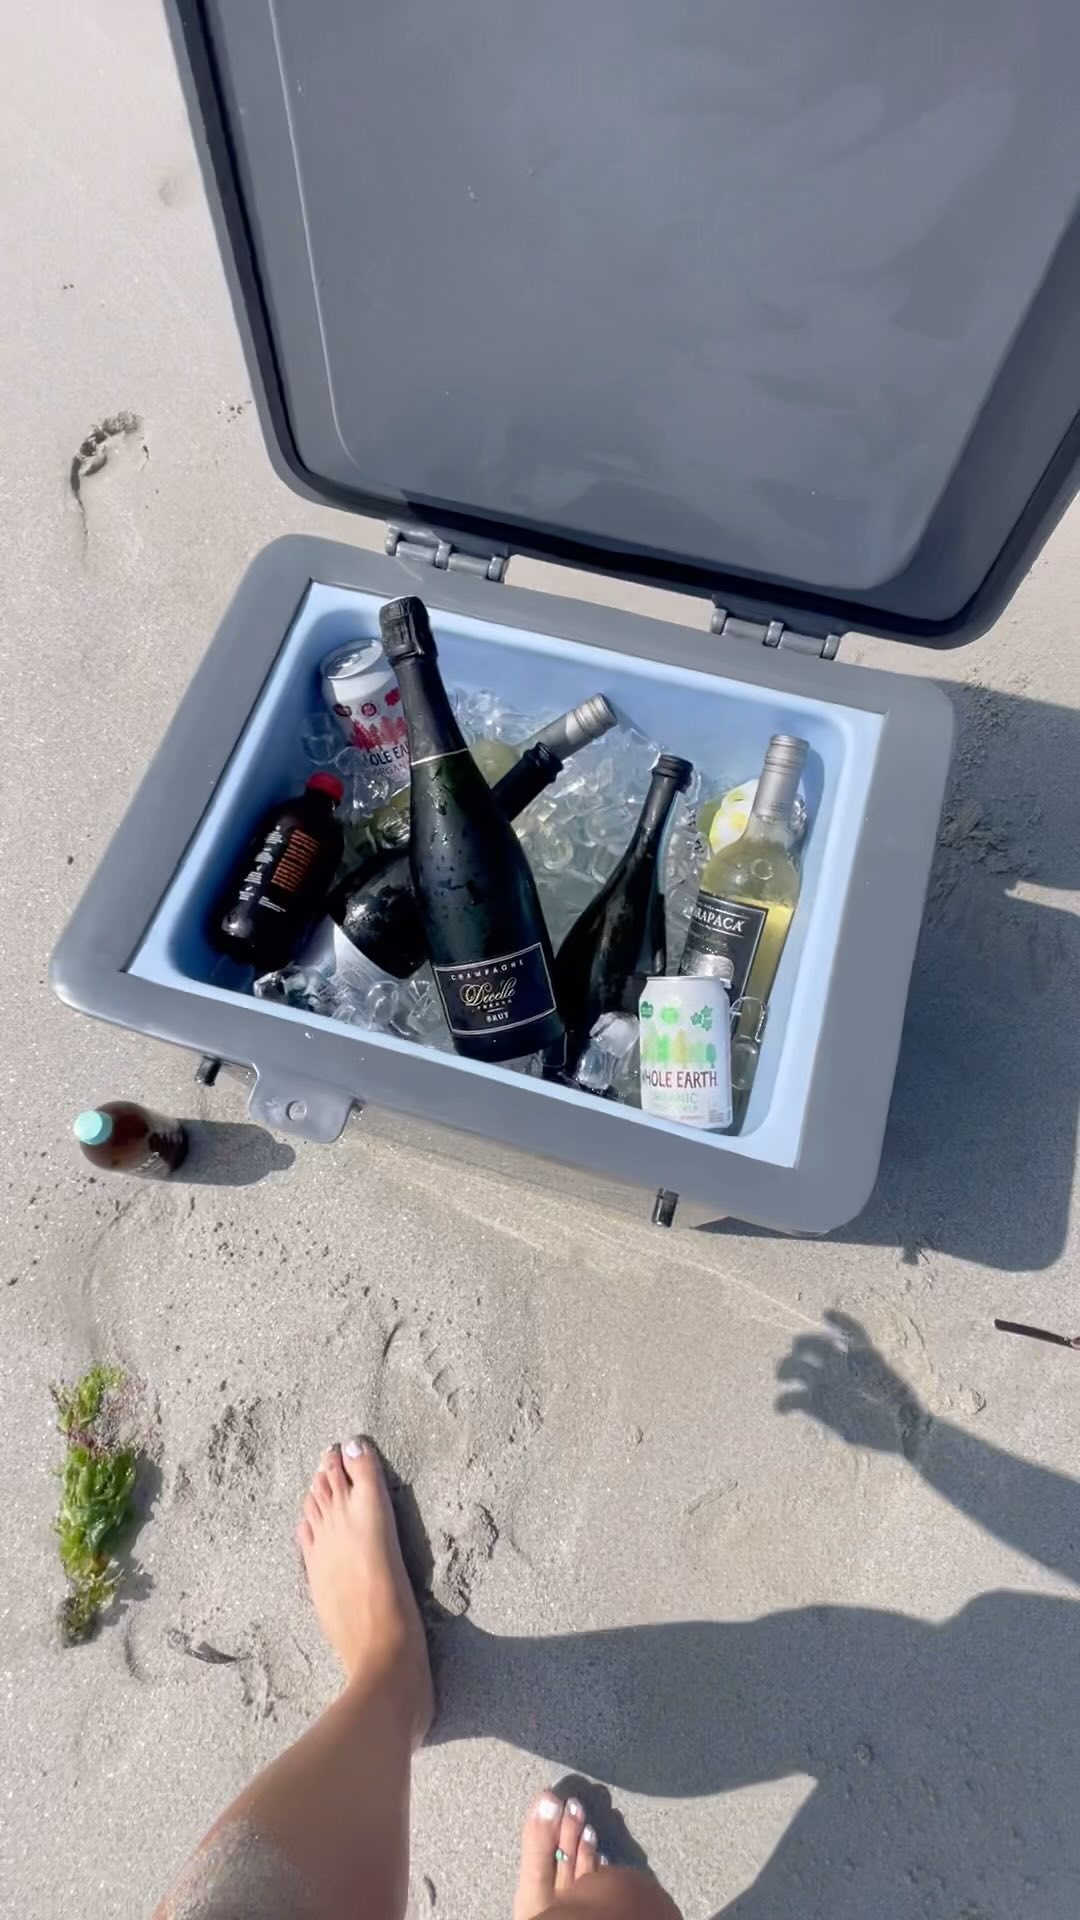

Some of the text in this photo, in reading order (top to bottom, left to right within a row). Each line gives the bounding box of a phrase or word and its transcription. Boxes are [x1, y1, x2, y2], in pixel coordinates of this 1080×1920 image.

[450, 960, 523, 981] CHAMPAGNE
[487, 1012, 509, 1023] BRUT
[677, 1071, 718, 1088] EARTH
